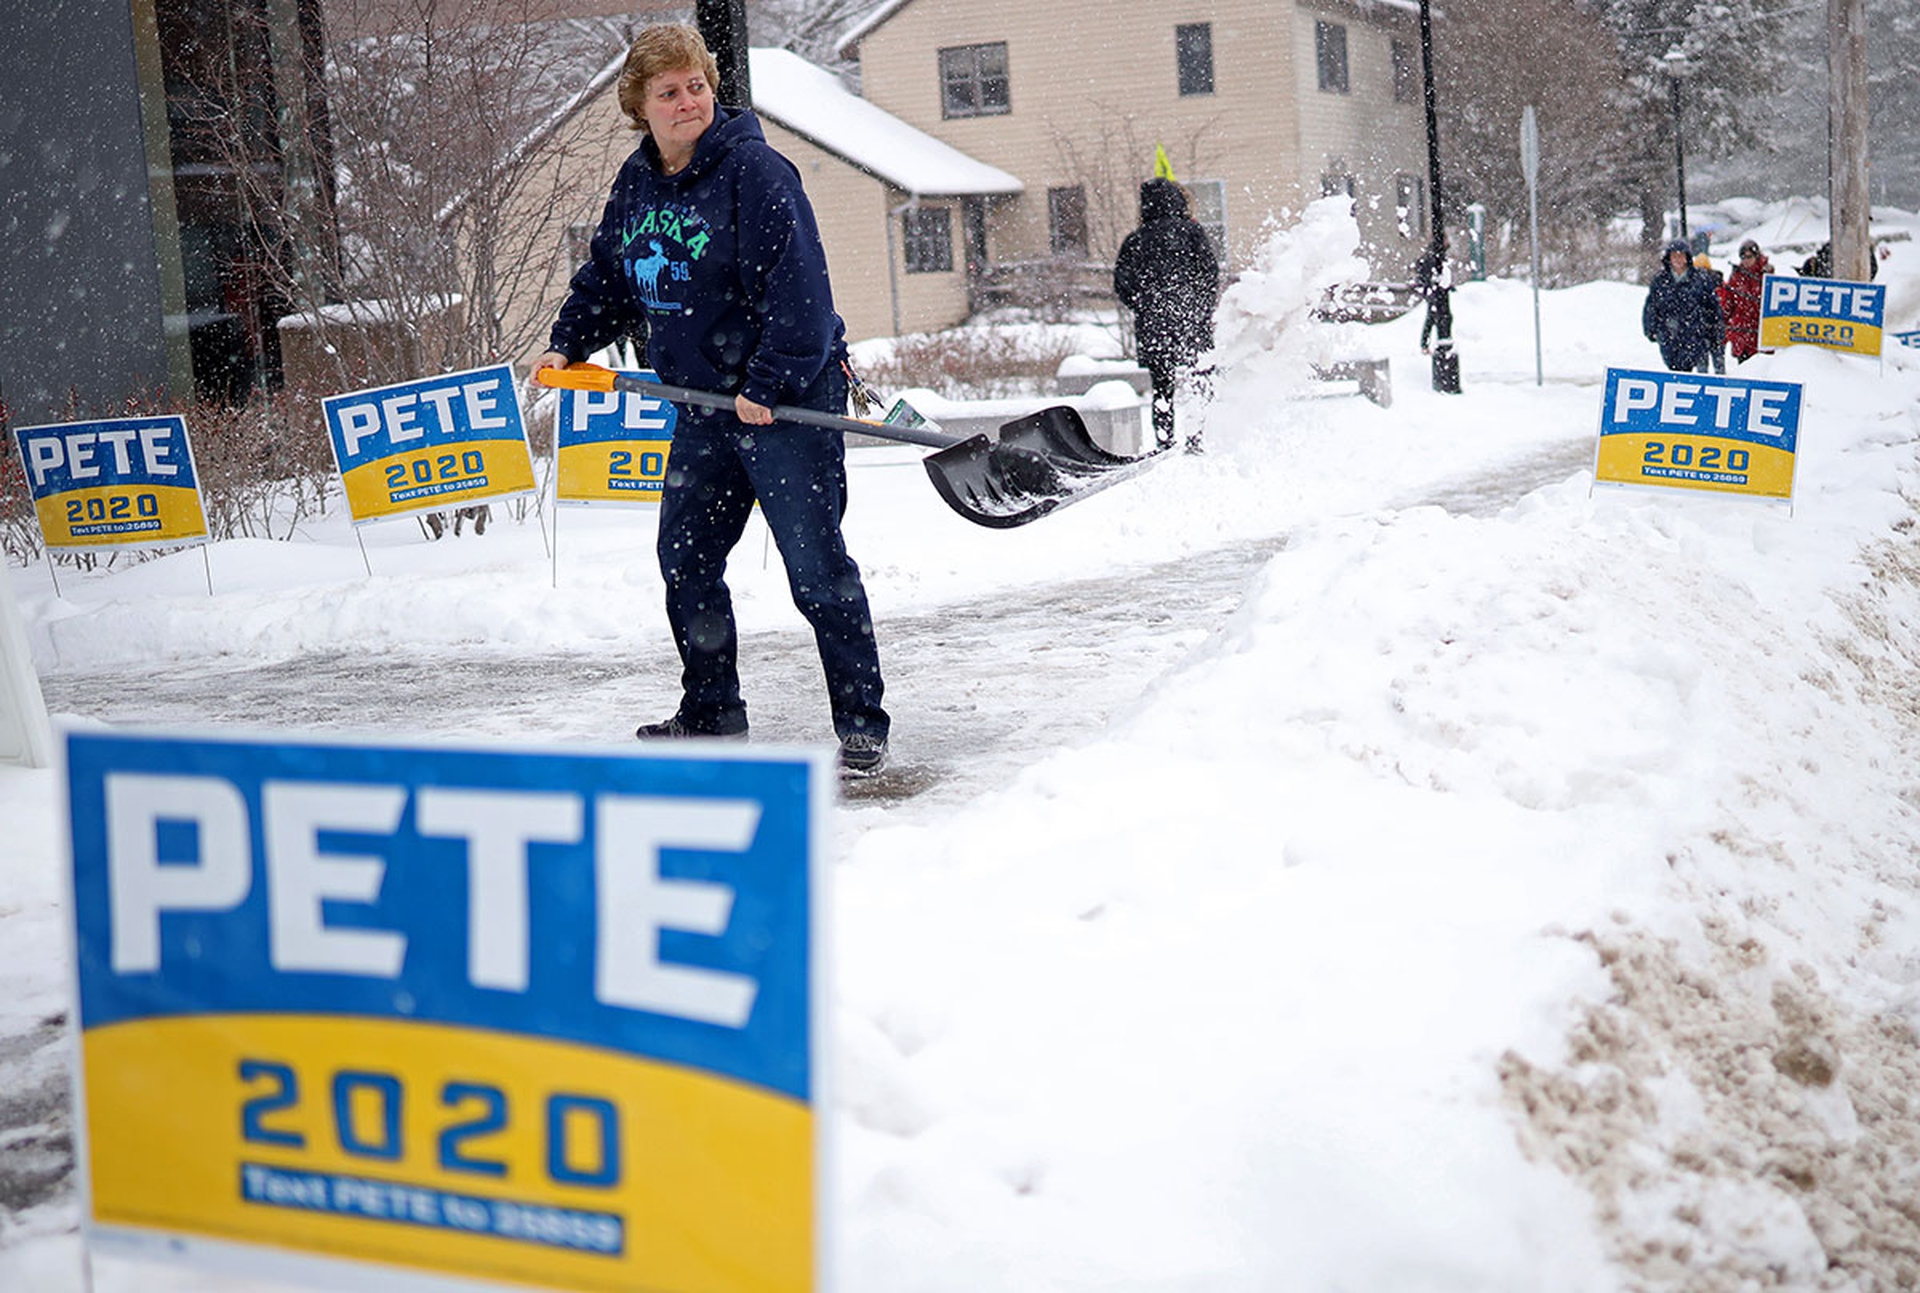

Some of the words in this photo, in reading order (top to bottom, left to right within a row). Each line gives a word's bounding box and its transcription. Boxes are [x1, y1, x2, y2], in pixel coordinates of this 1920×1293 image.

[1769, 281, 1877, 319] PETE
[1790, 321, 1854, 340] 2020
[337, 378, 507, 457] PETE
[1613, 378, 1789, 437] PETE
[28, 427, 179, 487] PETE
[385, 450, 485, 489] 2020
[609, 451, 663, 476] 20
[1644, 442, 1750, 471] 2020
[1644, 466, 1667, 476] Text
[1668, 468, 1697, 479] PETE
[1699, 471, 1711, 480] to
[392, 490, 416, 500] Text
[417, 485, 442, 496] PETE
[443, 483, 455, 491] to
[610, 479, 636, 489] Text
[639, 481, 664, 489] PET
[66, 494, 159, 522] 2020
[71, 525, 91, 535] Text
[91, 523, 112, 534] PETE
[113, 523, 125, 533] to
[103, 773, 764, 1029] PETE
[236, 1058, 624, 1189] 2020
[243, 1164, 328, 1208] Text
[331, 1175, 441, 1225] PETE
[442, 1198, 492, 1232] to
